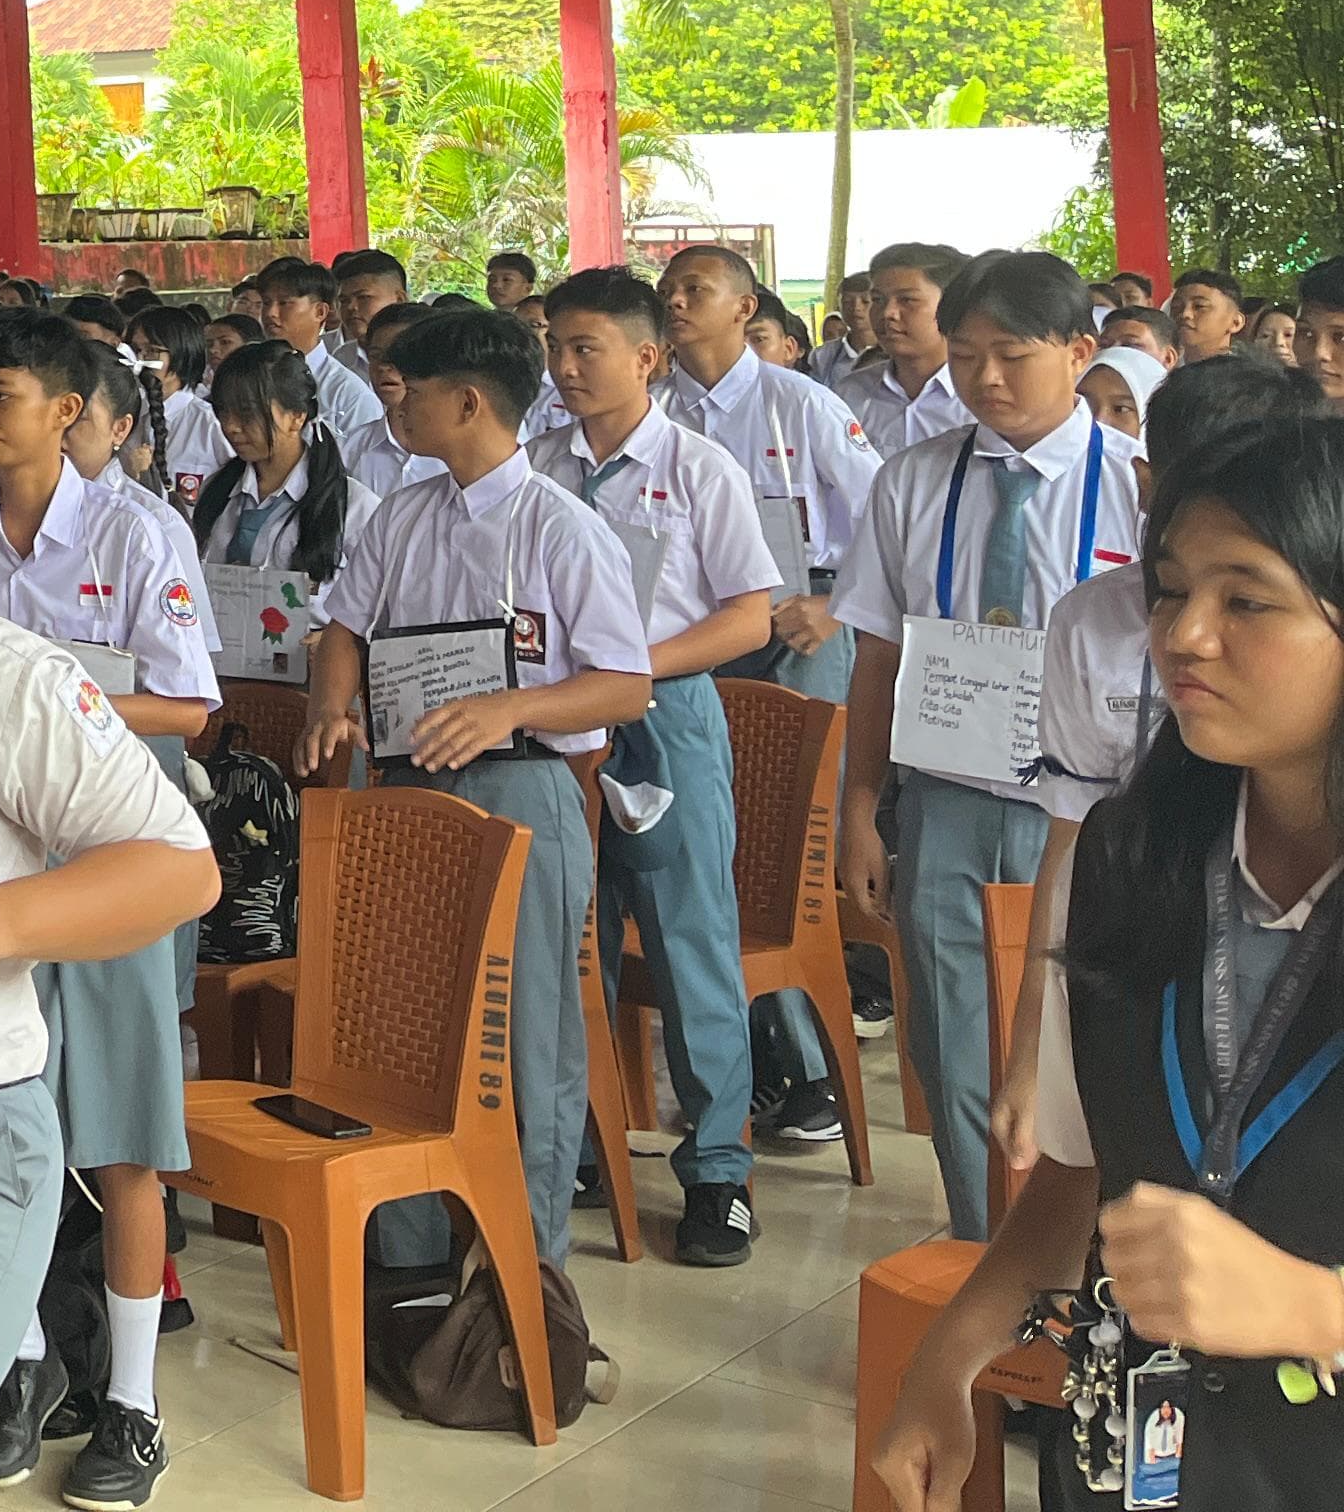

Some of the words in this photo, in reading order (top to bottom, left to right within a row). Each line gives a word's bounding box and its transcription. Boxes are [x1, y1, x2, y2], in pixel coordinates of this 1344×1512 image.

[925, 654, 950, 669] NAMA
[804, 803, 830, 889] ALUMNI
[802, 897, 823, 924] 89
[480, 954, 510, 1063] ALUMNI
[478, 1072, 503, 1110] 89
